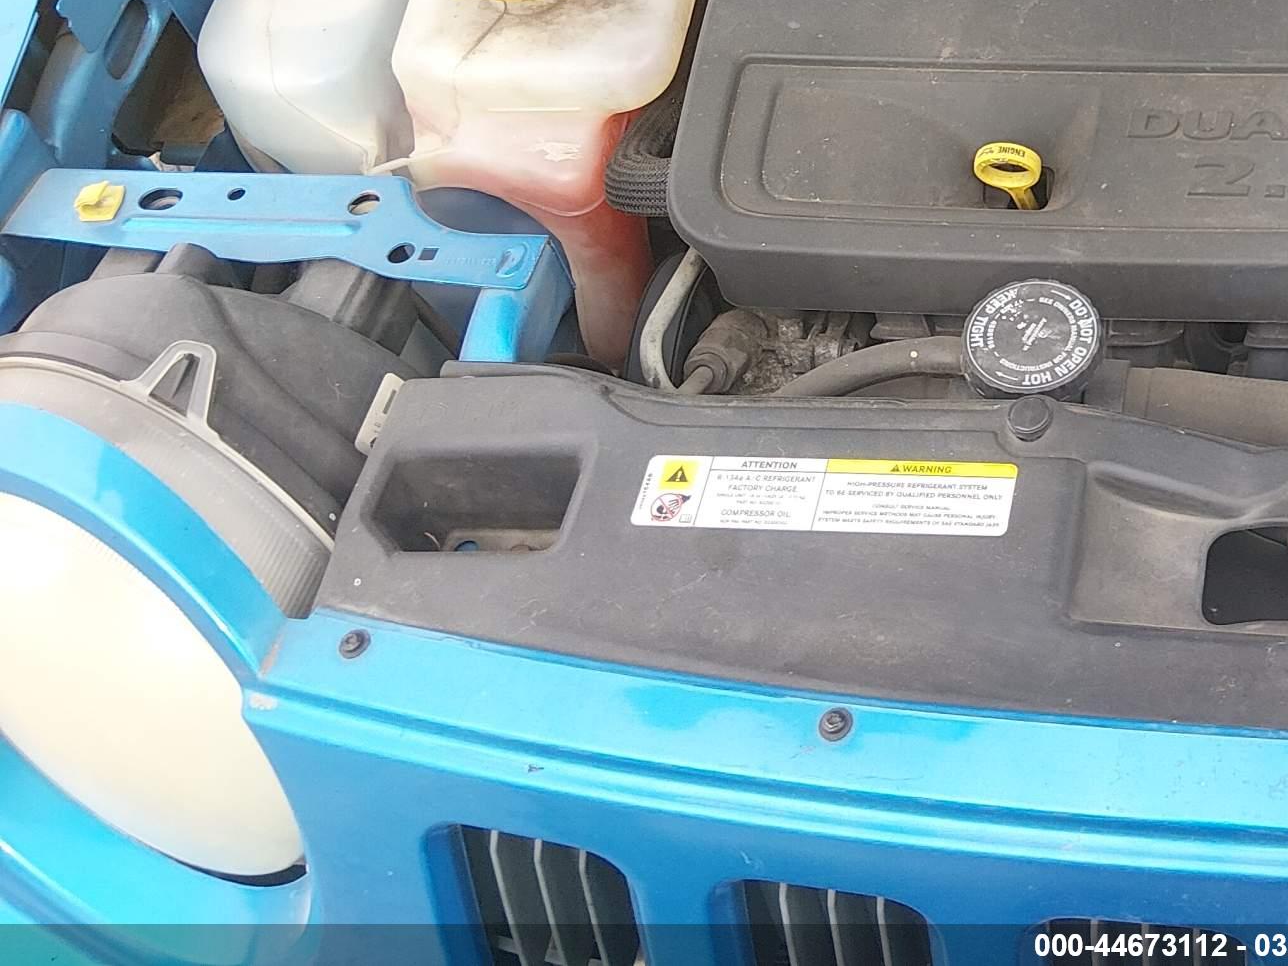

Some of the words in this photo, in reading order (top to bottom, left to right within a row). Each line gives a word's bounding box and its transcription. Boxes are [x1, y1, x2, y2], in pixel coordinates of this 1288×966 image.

[998, 145, 1026, 158] ENGINE
[984, 288, 1018, 315] KEEP
[1068, 298, 1088, 317] DO
[970, 315, 990, 348] TIGHT
[1077, 317, 1094, 344] NOT
[1054, 346, 1088, 377] OPEN
[1022, 371, 1052, 386] HOT
[740, 460, 798, 470] ATTENTION
[902, 464, 952, 474] WARNING
[762, 474, 816, 483] REFRIGERANT
[728, 484, 763, 492] FACTORY
[764, 485, 798, 493] CHARGE
[906, 482, 958, 490] REFRIGERANT
[937, 492, 982, 500] PERSONNEL
[720, 509, 775, 518] COMPRESSOR
